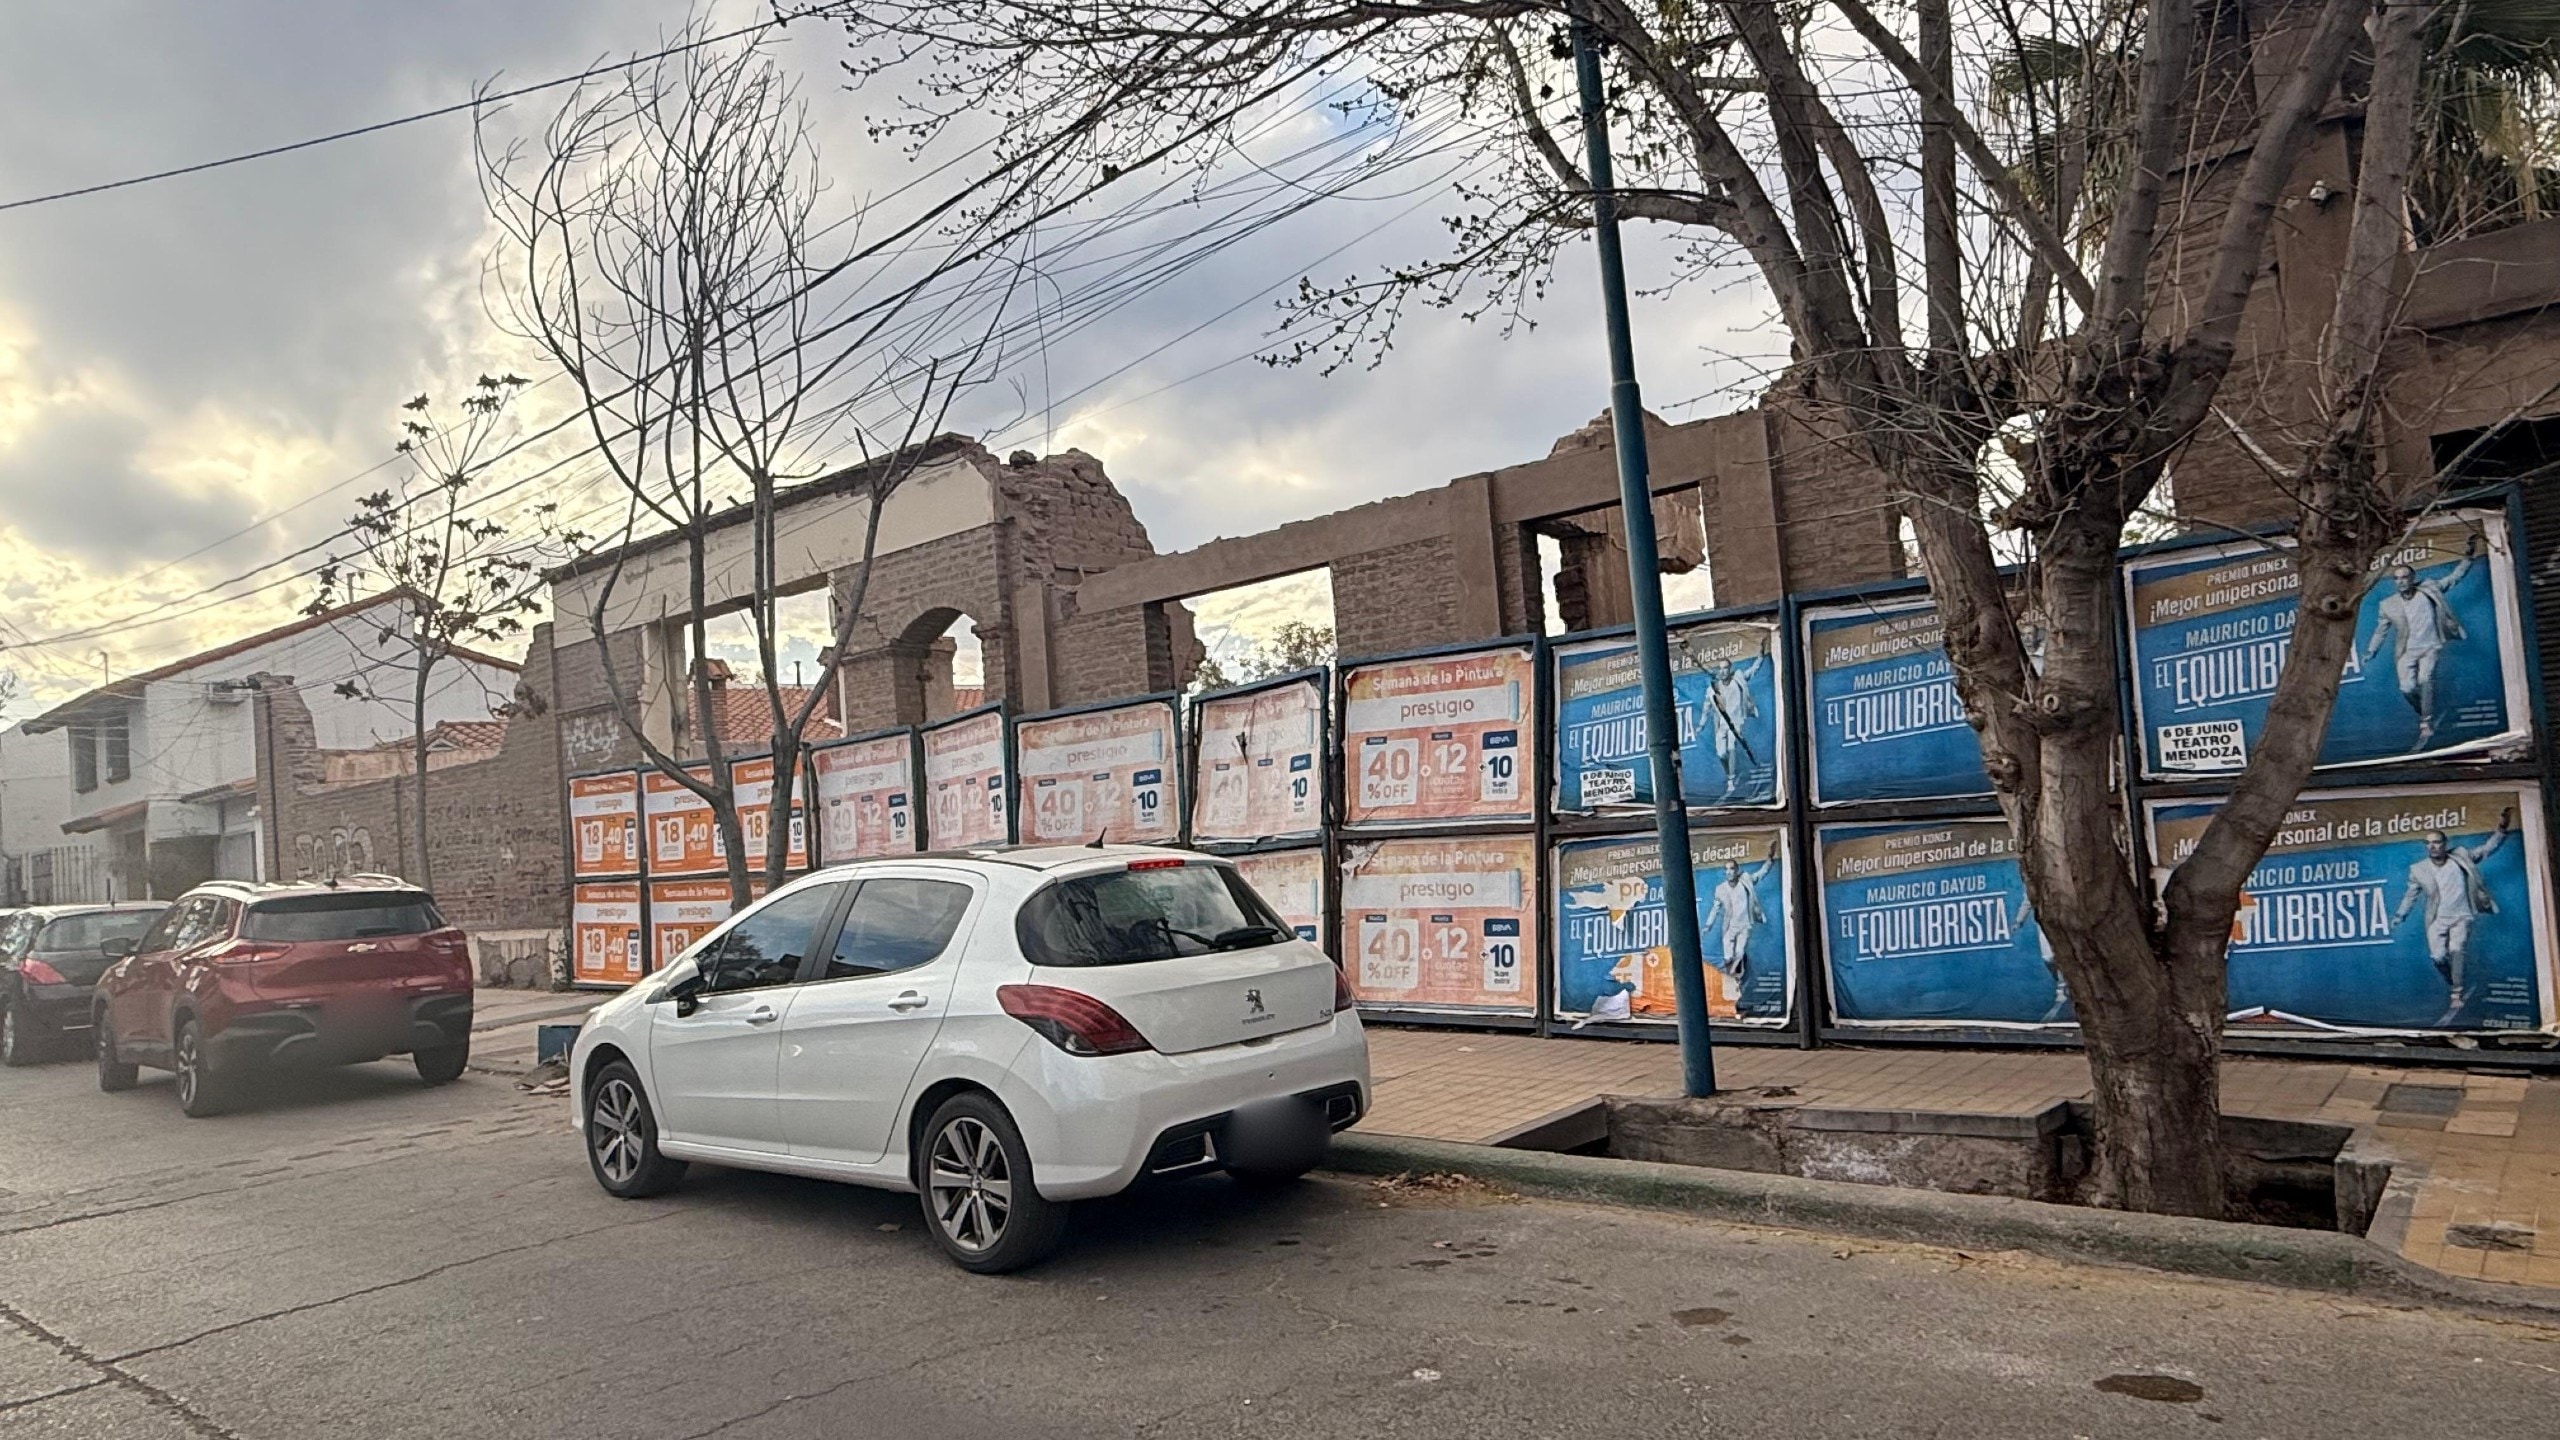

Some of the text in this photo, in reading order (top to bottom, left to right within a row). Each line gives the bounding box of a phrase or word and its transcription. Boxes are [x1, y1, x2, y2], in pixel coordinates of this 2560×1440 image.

[2206, 557, 2289, 586] PREMIO KONEX
[2150, 573, 2302, 624] ¡Mejor unipersona
[1873, 614, 1940, 637] PREMIO KONEX
[2186, 615, 2269, 649] MAURICIO
[1825, 642, 1870, 667] ¡Mejor
[1373, 666, 1504, 692] Semana de la Pintura
[1569, 678, 1603, 697] ¡Mejor
[1682, 656, 1692, 670] la
[1698, 640, 1743, 663] década!
[1853, 665, 1923, 691] MAURICIO
[2155, 663, 2171, 689] EL
[1400, 698, 1475, 723] prestigio
[1591, 695, 1644, 719] MAURICIO
[1827, 682, 1967, 743] EL EQUILIBRIS
[1085, 724, 1100, 736] de
[1112, 717, 1150, 733] Pintura
[2163, 722, 2238, 738] 6 DE JUNIO
[1569, 729, 1579, 750] EL
[2172, 734, 2231, 749] TEATRO
[1066, 744, 1128, 767] prestigio
[1434, 742, 1467, 775] 12
[2165, 745, 2242, 761] MENDOZA
[1368, 748, 1411, 782] 40
[1487, 755, 1513, 779] 10
[1291, 777, 1308, 799] 10
[1367, 783, 1409, 800] % OFF
[1583, 785, 1632, 798] MENDOZA
[1588, 778, 1628, 788] TEATRO
[940, 792, 959, 818] 40
[990, 793, 1002, 813] 10
[1041, 789, 1076, 817] 40
[1094, 781, 1122, 810] 12
[1137, 789, 1158, 811] 10
[863, 802, 882, 826] 12
[892, 811, 906, 829] 10
[1054, 817, 1076, 831] OFF
[2282, 810, 2316, 826] ONEX
[2337, 819, 2361, 839] de
[2365, 816, 2381, 836] la
[2387, 806, 2467, 835] década!
[585, 824, 600, 846] 18
[606, 826, 622, 846] 40
[660, 821, 680, 844] 18
[689, 823, 708, 843] 40
[747, 815, 764, 839] 18
[792, 821, 803, 836] 10
[1885, 831, 1953, 850] PREMIO KONEX
[1422, 852, 1438, 866] de
[1440, 851, 1451, 865] la
[1455, 850, 1504, 865] Pintura
[1569, 864, 1603, 885] ¡Mejor
[1702, 842, 1750, 862] década!
[1836, 857, 1880, 879] ¡Mejor
[1884, 842, 1965, 869] unipersonal
[1968, 839, 1986, 857] de
[1990, 837, 2004, 852] la
[2301, 860, 2359, 884] DAYUB
[1400, 881, 1475, 902] prestigio
[1867, 874, 1986, 904] MAURICIO DAYUB
[678, 904, 713, 917] prestigio
[1570, 919, 1581, 940] EL
[1841, 898, 2011, 959] EL EQUILIBRISTA
[586, 932, 601, 953] 18
[611, 936, 624, 954] 40
[629, 943, 638, 956] 10
[665, 933, 685, 955] 18
[1367, 928, 1411, 962] 40
[1434, 926, 1469, 959] 12
[1489, 943, 1515, 968] 10
[1367, 962, 1411, 980] % OFF
